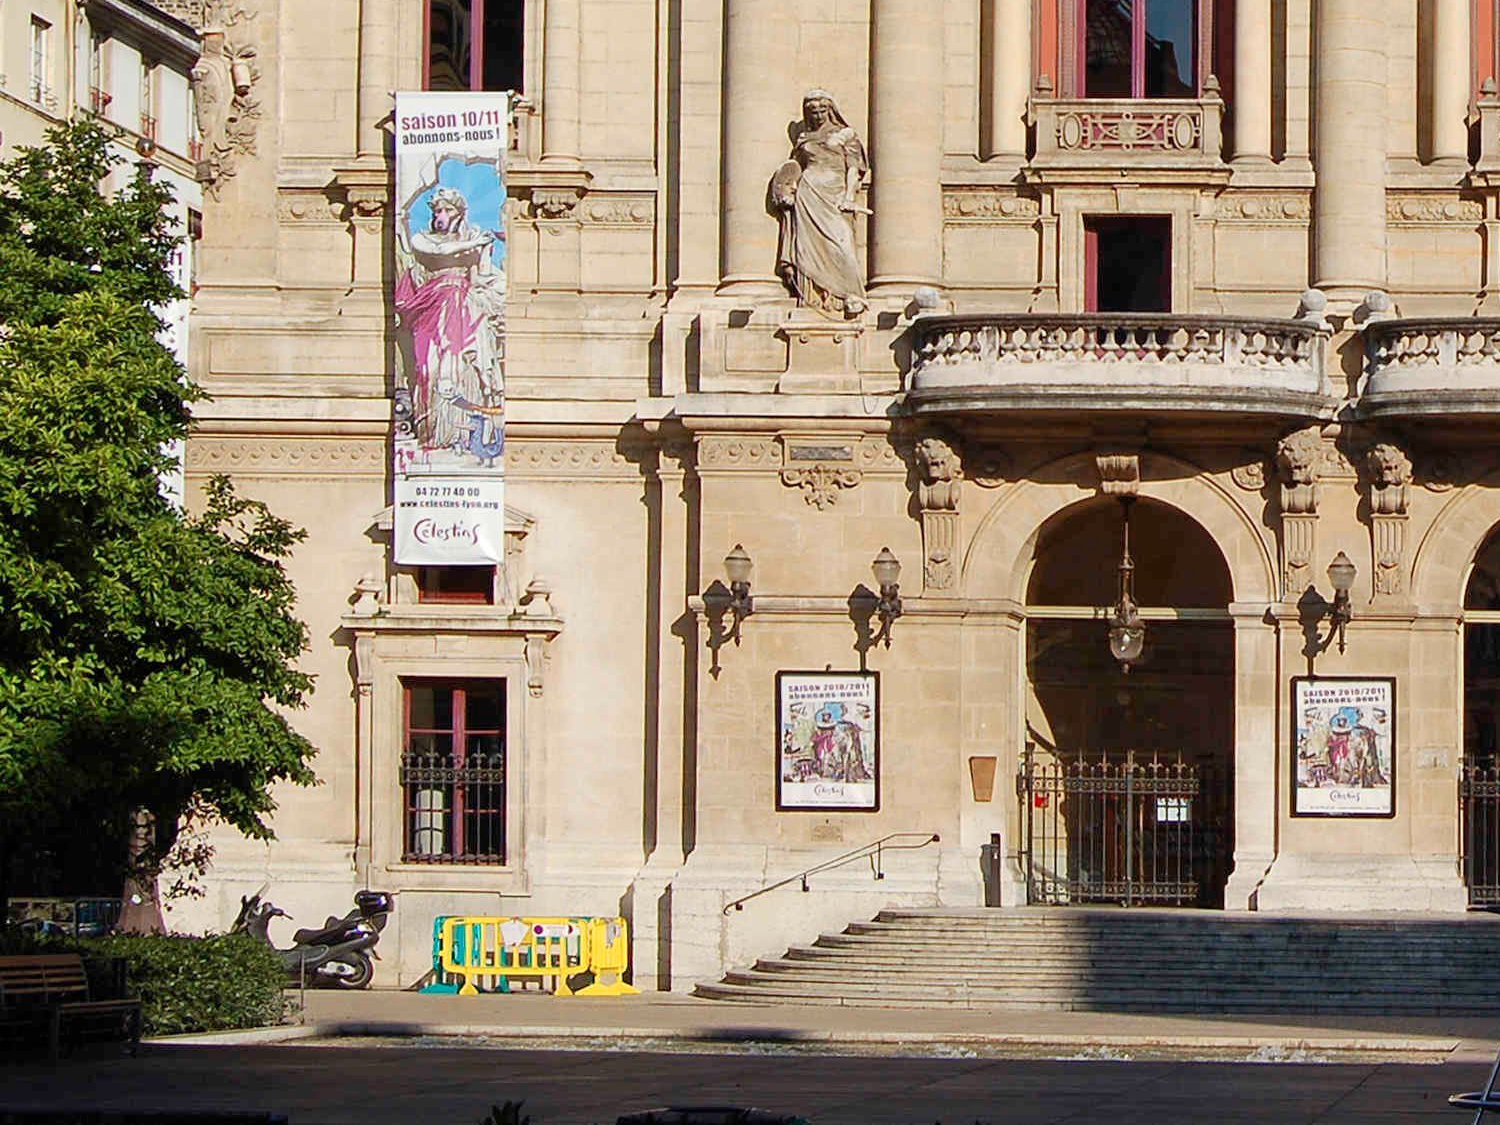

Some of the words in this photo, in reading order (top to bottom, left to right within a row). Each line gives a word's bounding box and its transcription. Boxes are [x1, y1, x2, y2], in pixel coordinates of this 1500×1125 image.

[401, 112, 457, 131] saison
[461, 110, 500, 127] 10/11
[430, 487, 440, 496] 72
